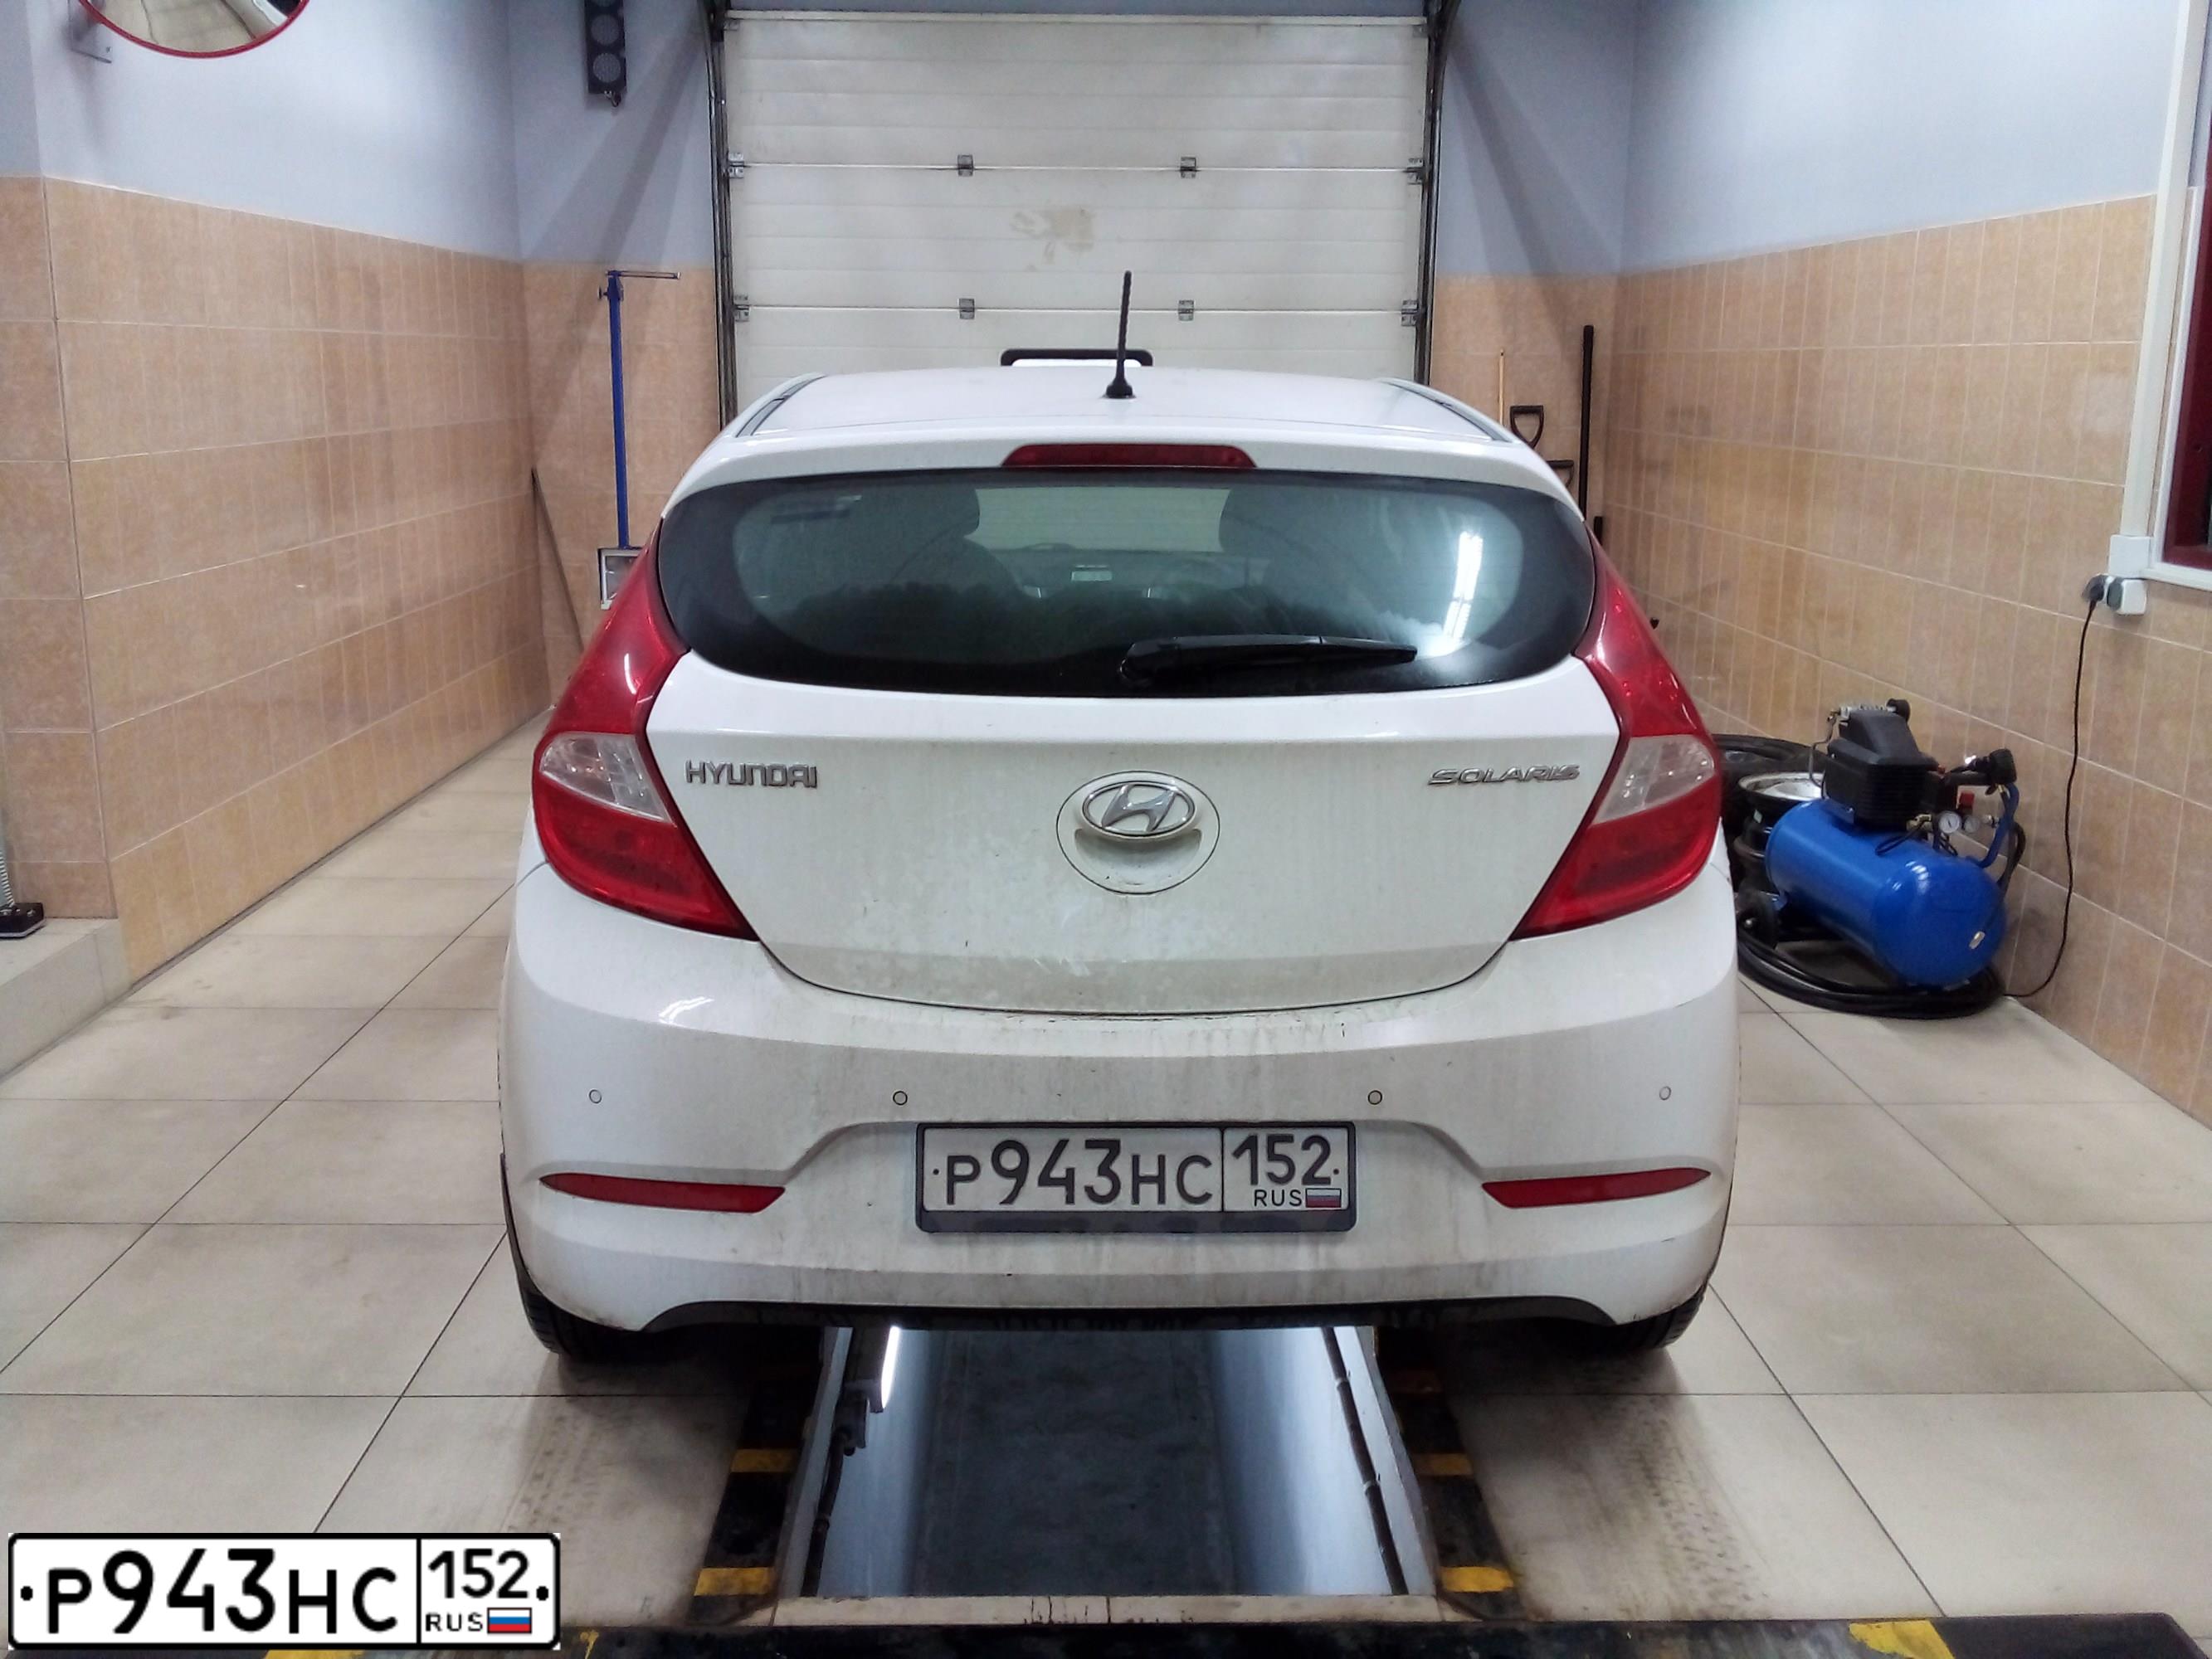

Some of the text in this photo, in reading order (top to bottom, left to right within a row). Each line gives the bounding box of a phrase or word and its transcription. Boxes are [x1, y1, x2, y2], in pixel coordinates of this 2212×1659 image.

[685, 760, 817, 788] HYUNDAI
[1428, 764, 1581, 786] SOLARIS
[1231, 1133, 1332, 1186] 152
[1253, 1189, 1303, 1208] RUS
